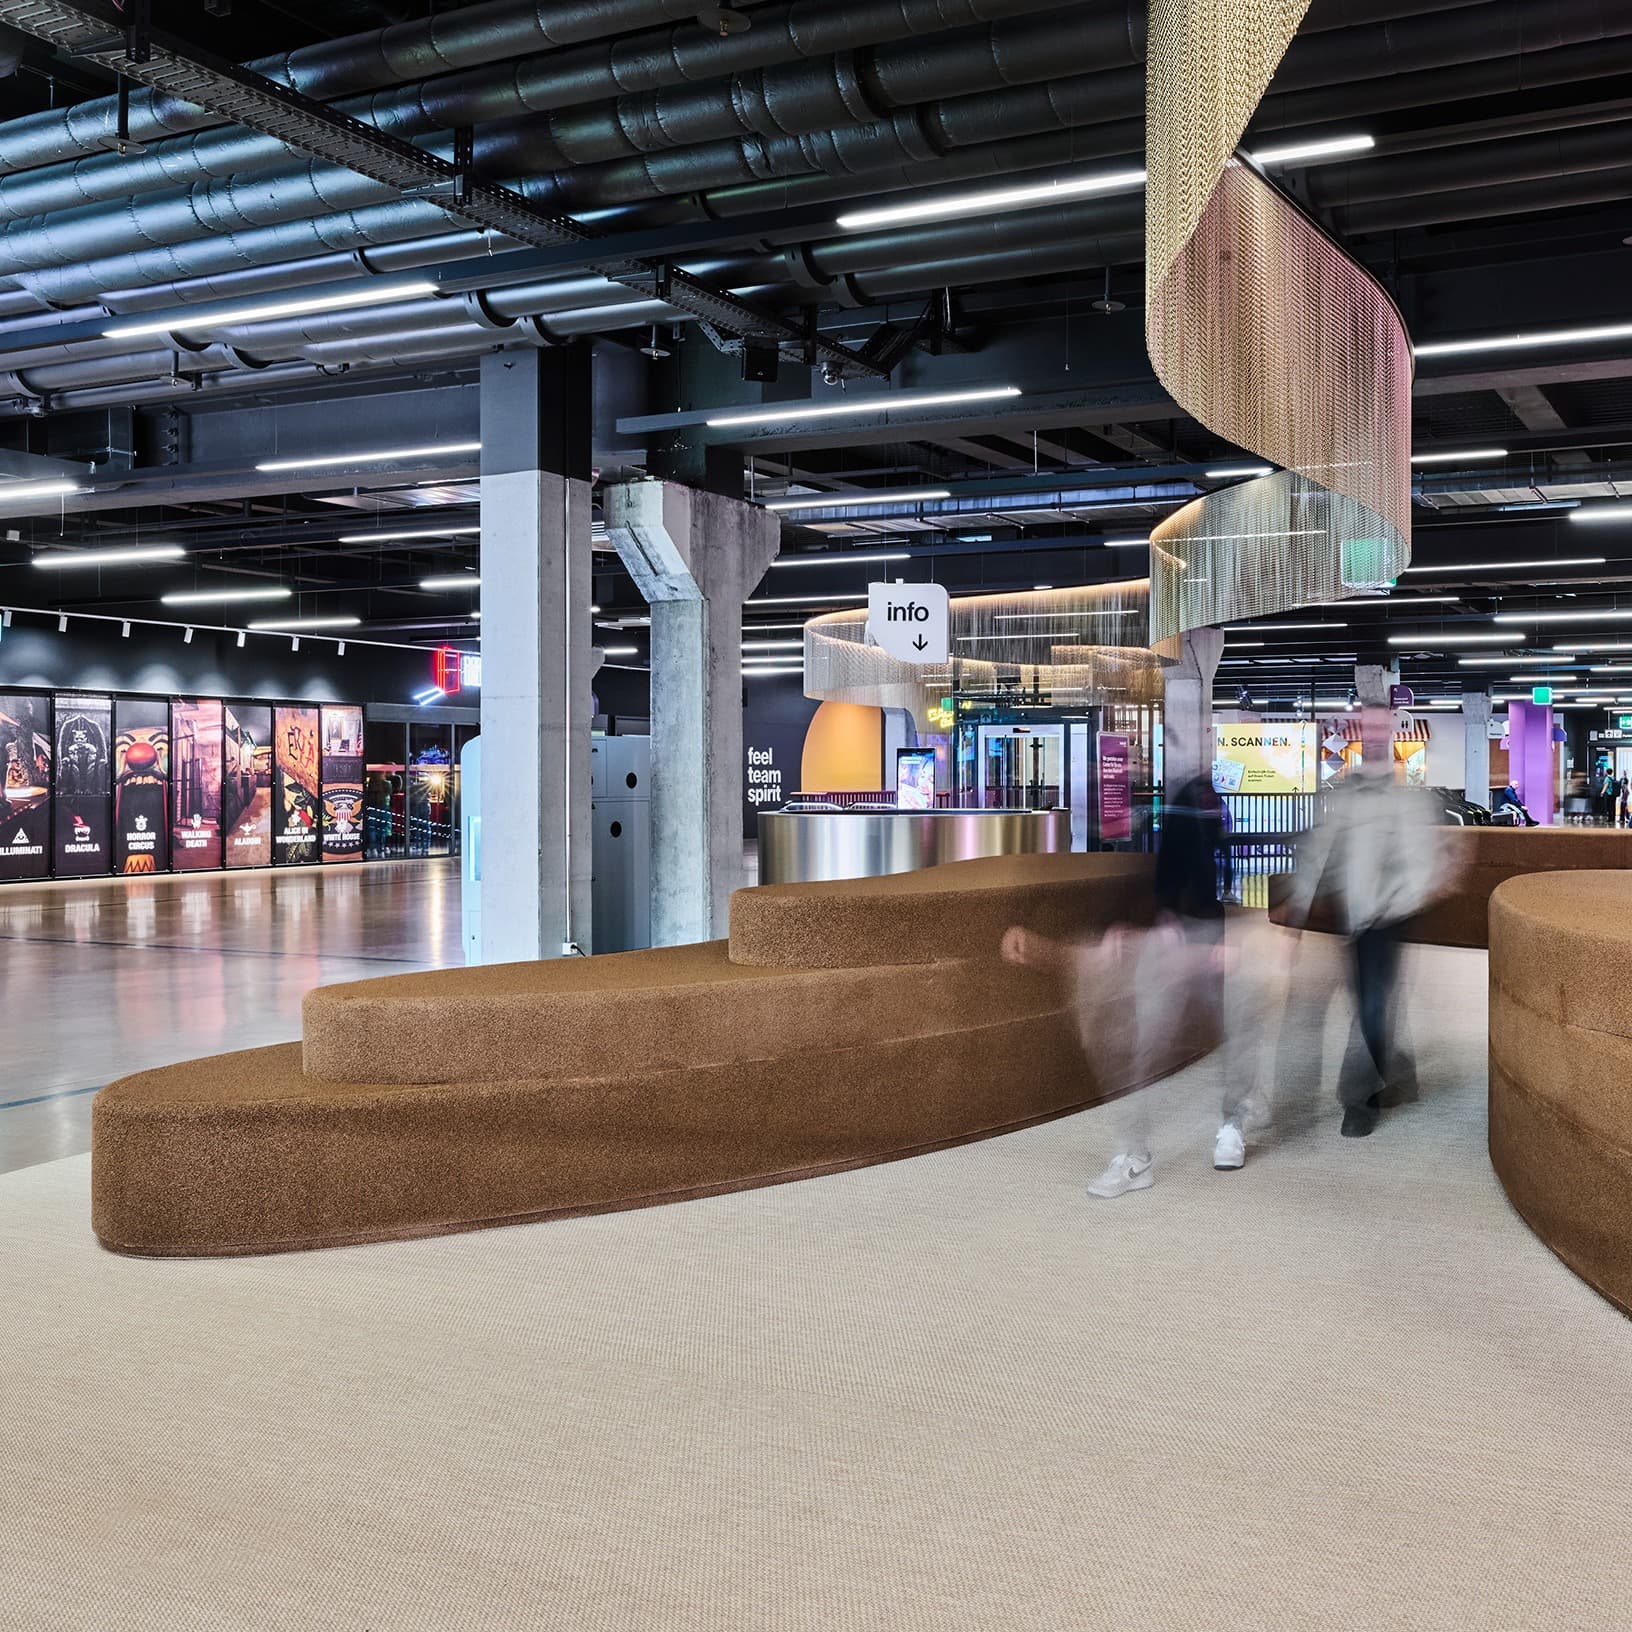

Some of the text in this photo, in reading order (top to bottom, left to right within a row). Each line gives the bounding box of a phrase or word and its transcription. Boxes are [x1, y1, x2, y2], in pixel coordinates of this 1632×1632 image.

[887, 601, 930, 622] info
[1231, 736, 1291, 747] SCANNEN.
[747, 746, 773, 765] feel
[747, 766, 782, 784] team
[747, 784, 782, 807] spirit
[126, 832, 157, 841] HORROR
[64, 843, 100, 853] DRACULA
[128, 841, 155, 850] CIRCUS
[185, 839, 208, 848] DEATH
